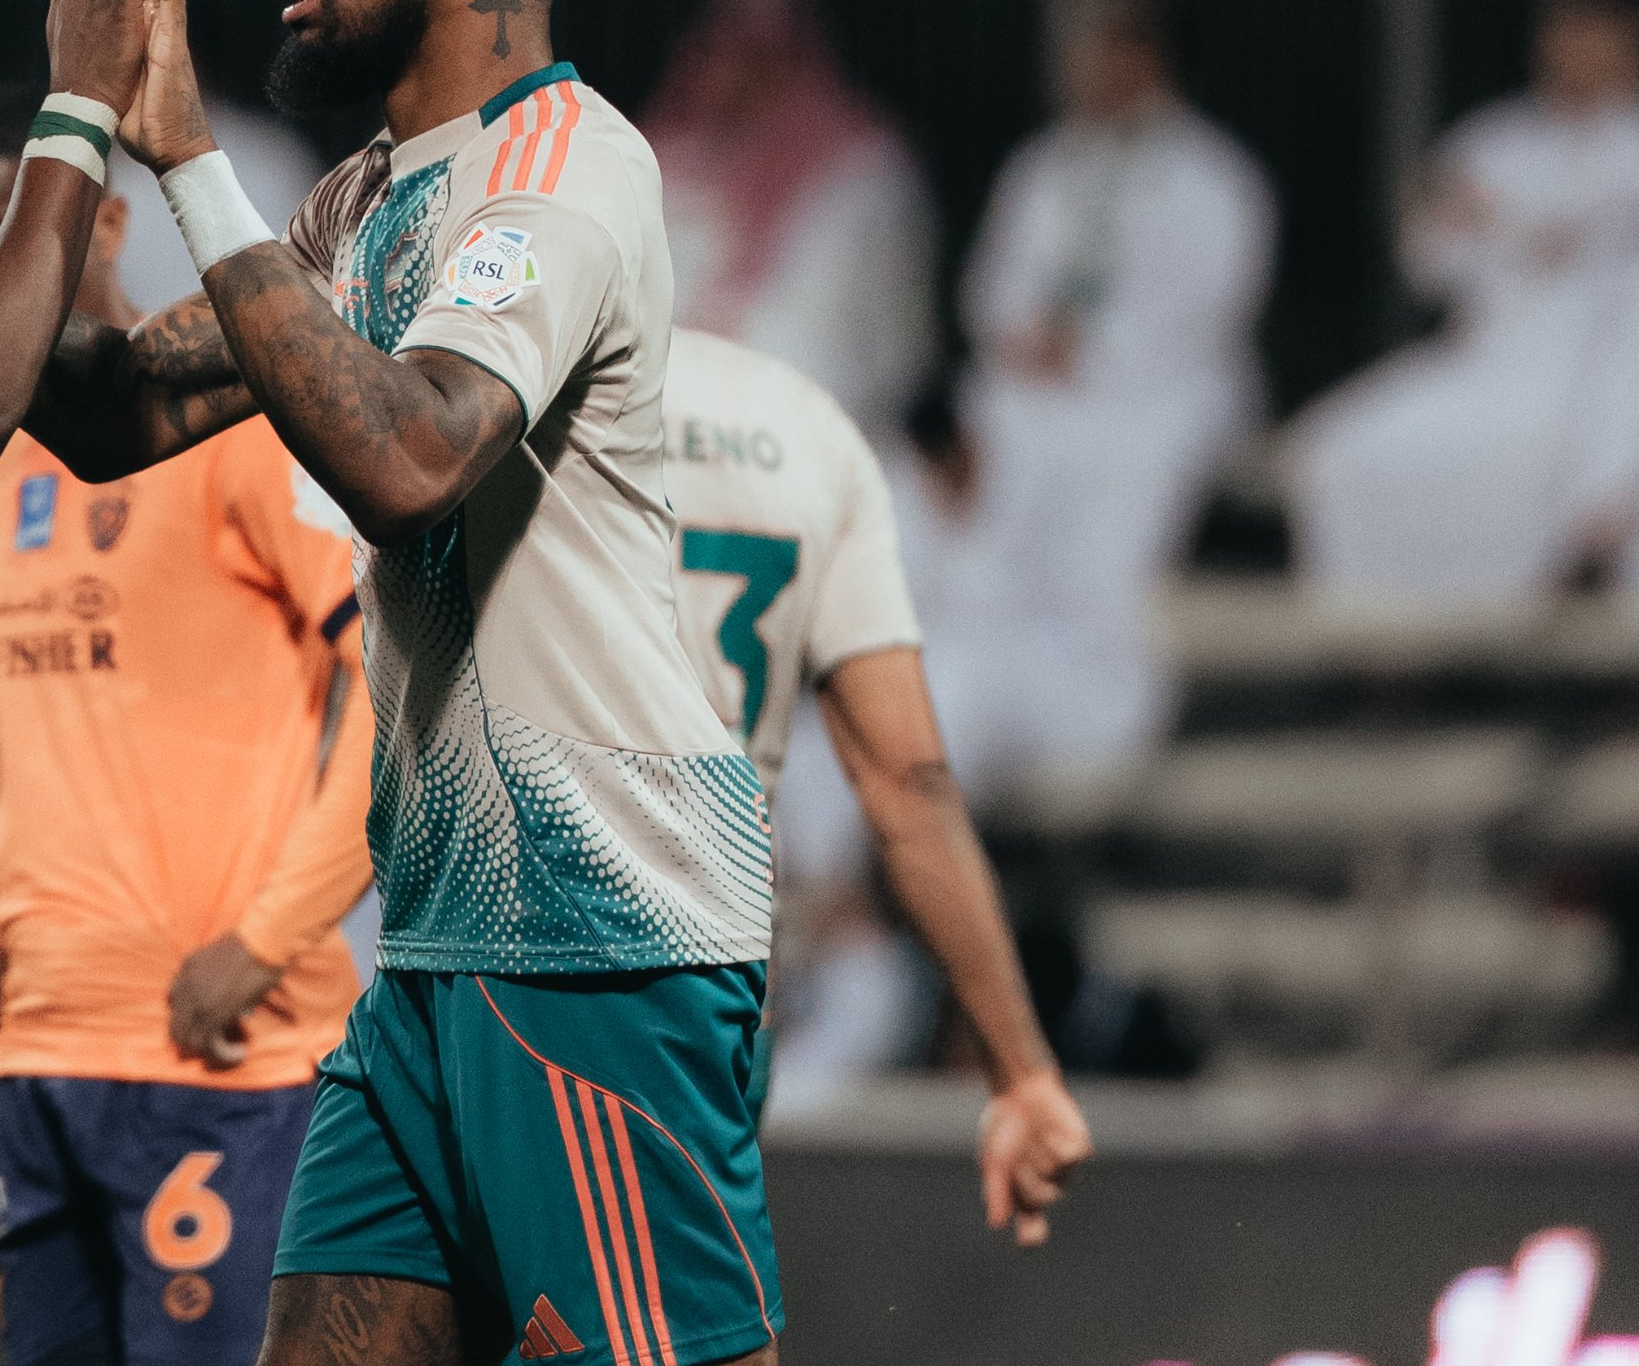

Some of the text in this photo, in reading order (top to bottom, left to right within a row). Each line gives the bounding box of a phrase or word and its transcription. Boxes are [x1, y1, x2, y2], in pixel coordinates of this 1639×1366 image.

[472, 260, 505, 280] RSL
[663, 416, 785, 473] ENO
[142, 1150, 234, 1271] 6
